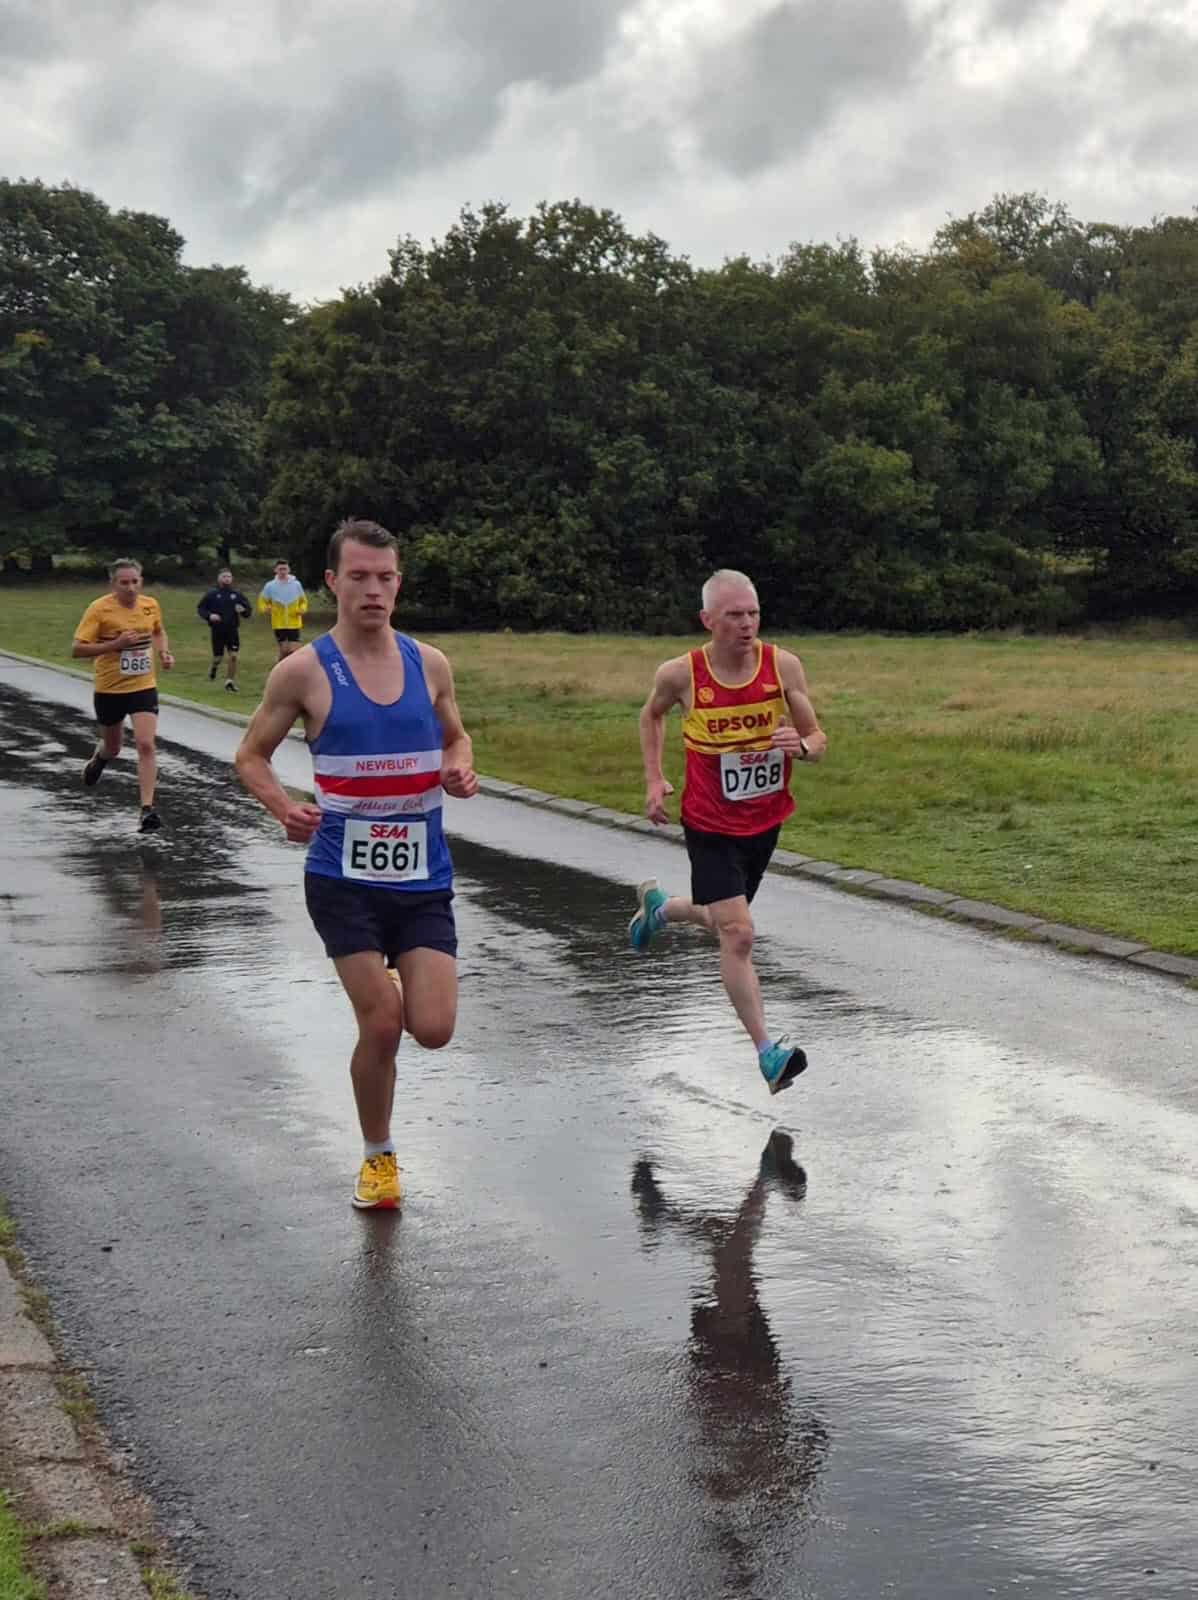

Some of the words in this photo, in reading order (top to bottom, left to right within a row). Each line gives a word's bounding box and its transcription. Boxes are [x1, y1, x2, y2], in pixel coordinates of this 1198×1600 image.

[707, 711, 773, 733] EPSOM
[356, 758, 418, 771] NEWBURY
[725, 763, 781, 793] D768
[370, 824, 409, 838] SEAA
[351, 840, 419, 871] E661
